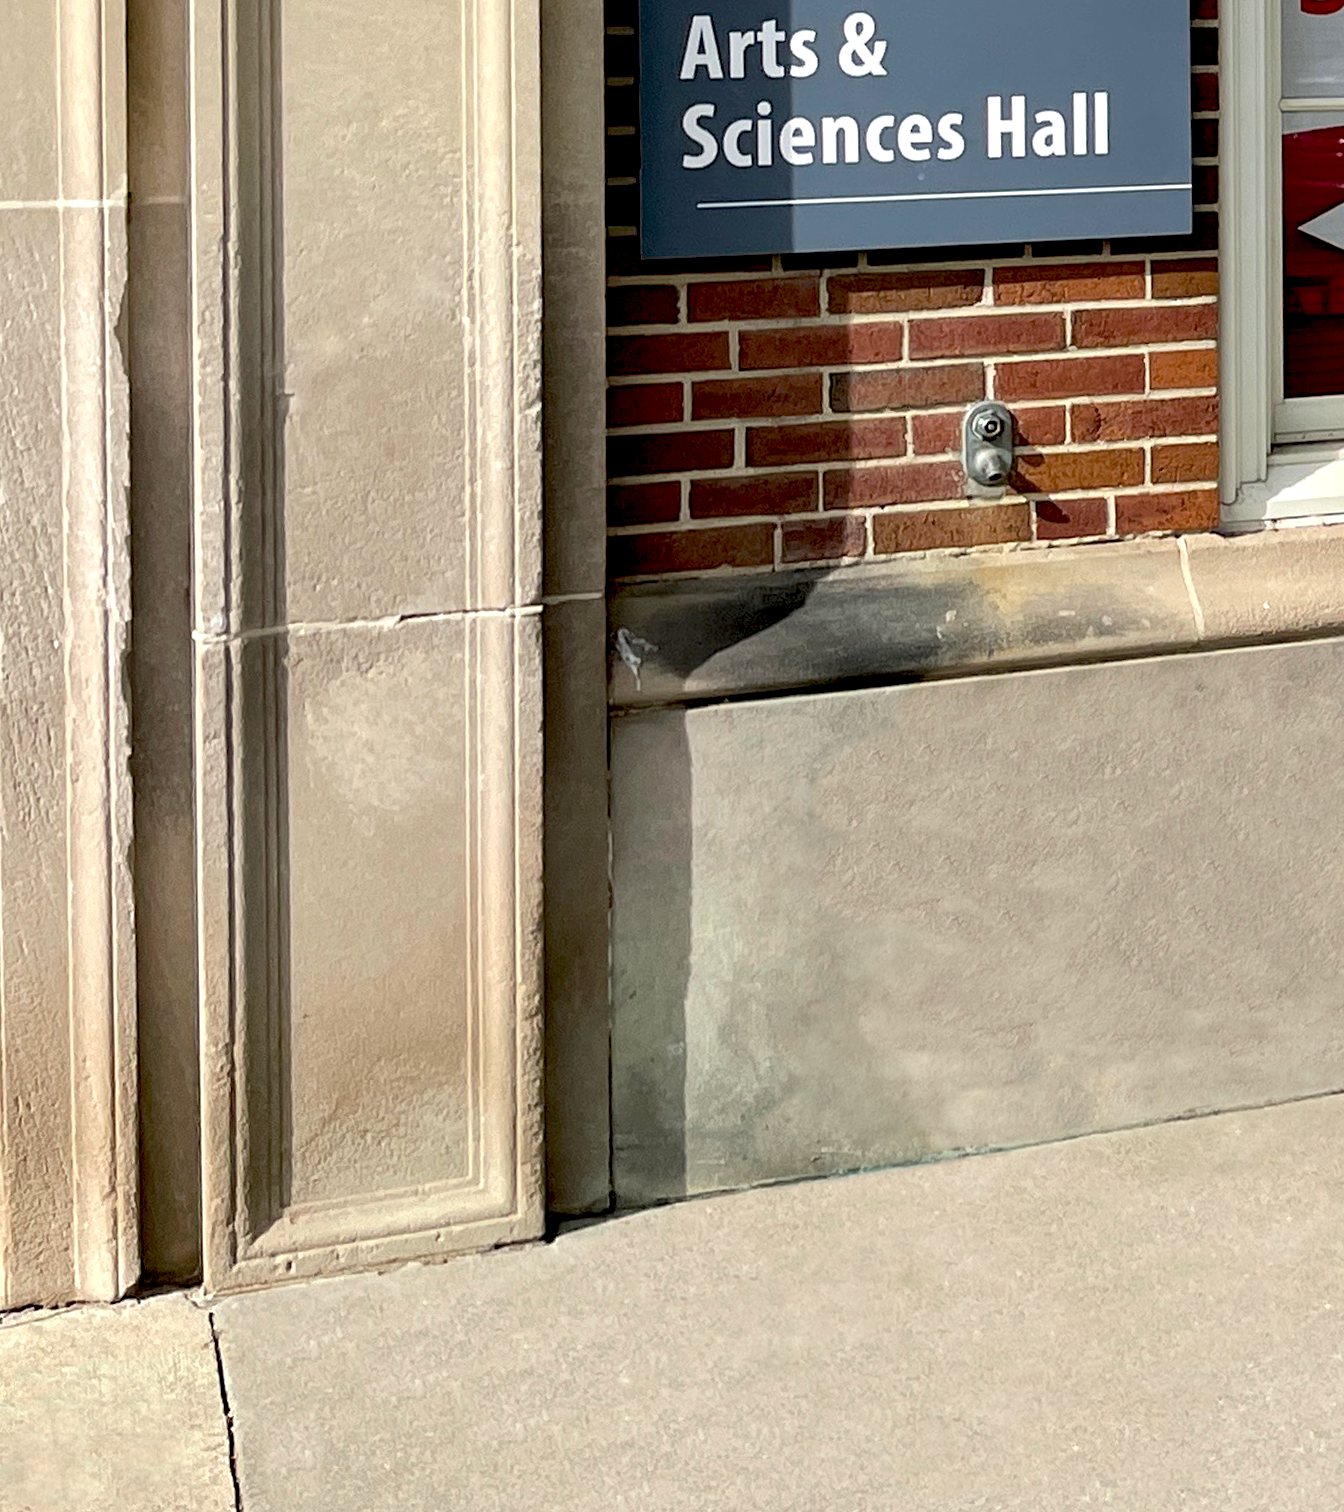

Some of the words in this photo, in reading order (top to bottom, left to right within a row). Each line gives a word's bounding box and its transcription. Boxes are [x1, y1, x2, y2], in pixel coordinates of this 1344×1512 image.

[680, 15, 818, 80] Arts
[838, 12, 888, 77] &
[682, 100, 964, 169] Sciences
[987, 91, 1109, 159] Hall
